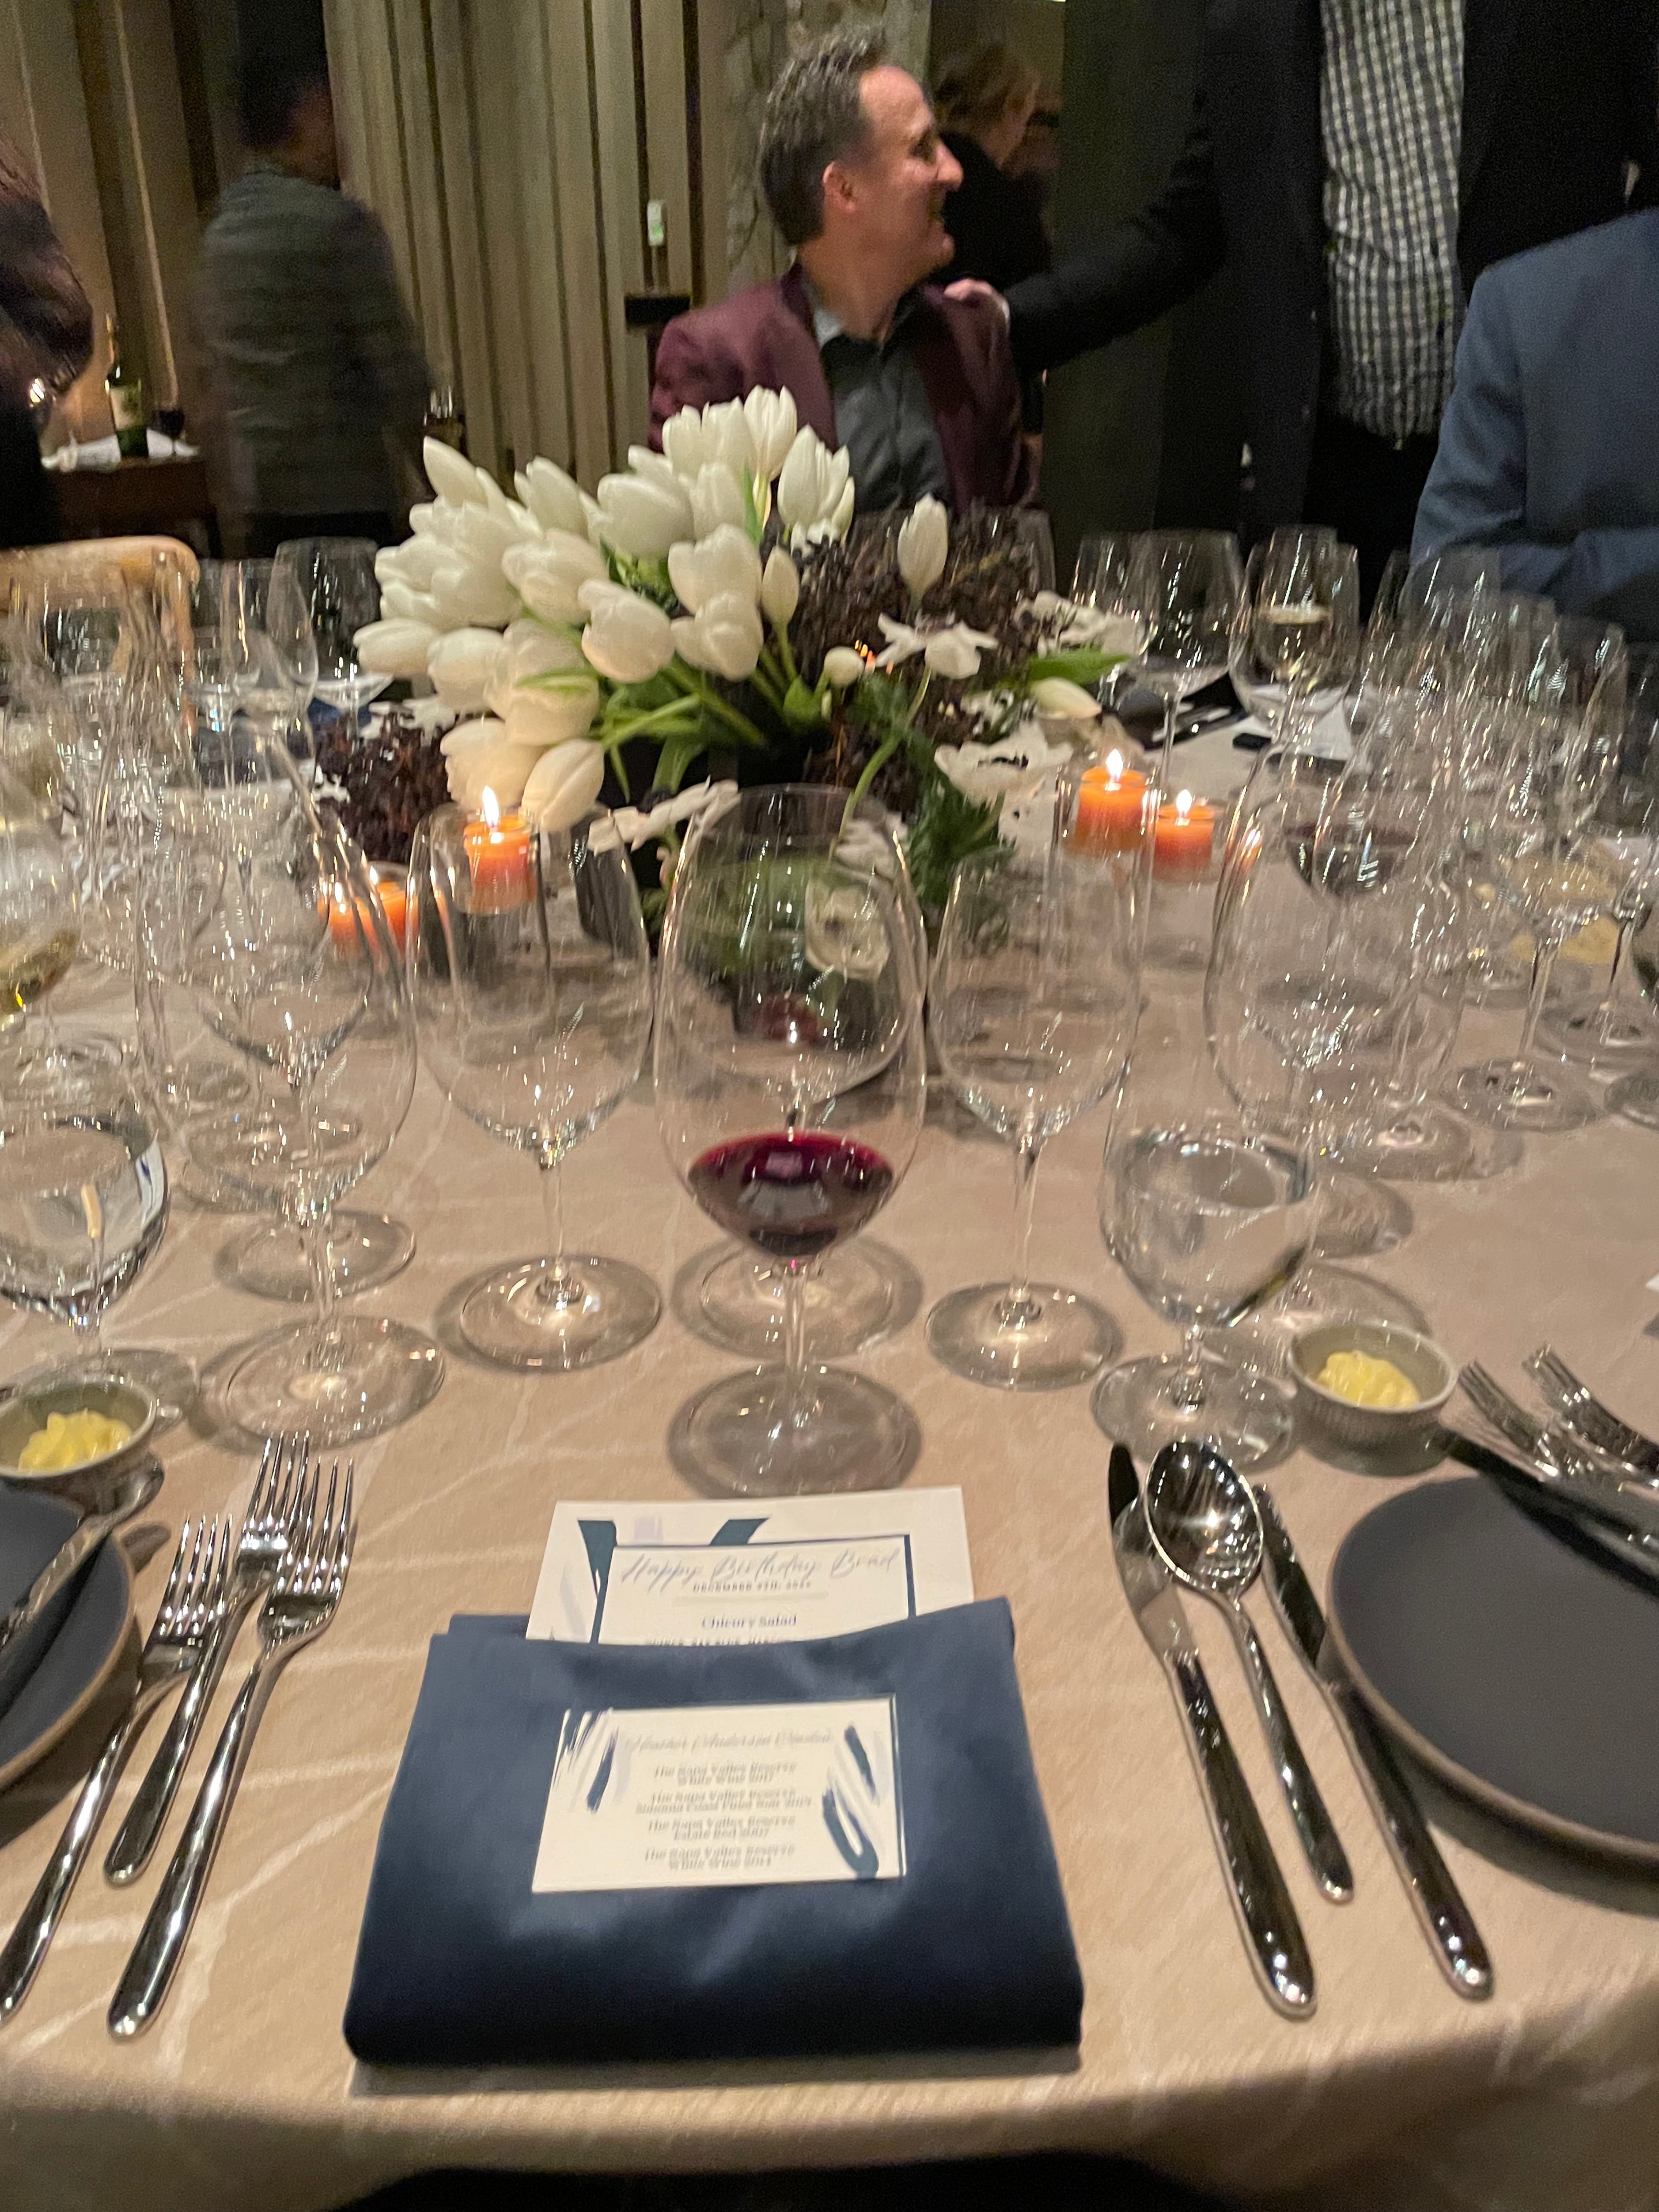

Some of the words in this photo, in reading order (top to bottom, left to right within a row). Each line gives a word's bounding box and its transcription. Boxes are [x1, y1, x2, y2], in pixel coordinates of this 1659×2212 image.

[621, 1554, 703, 1594] Happy
[712, 1551, 816, 1582] Birthday
[830, 1547, 901, 1580] Brad
[693, 1581, 752, 1593] DECEMBER
[702, 1616, 753, 1630] Chicory
[758, 1613, 797, 1627] Salad
